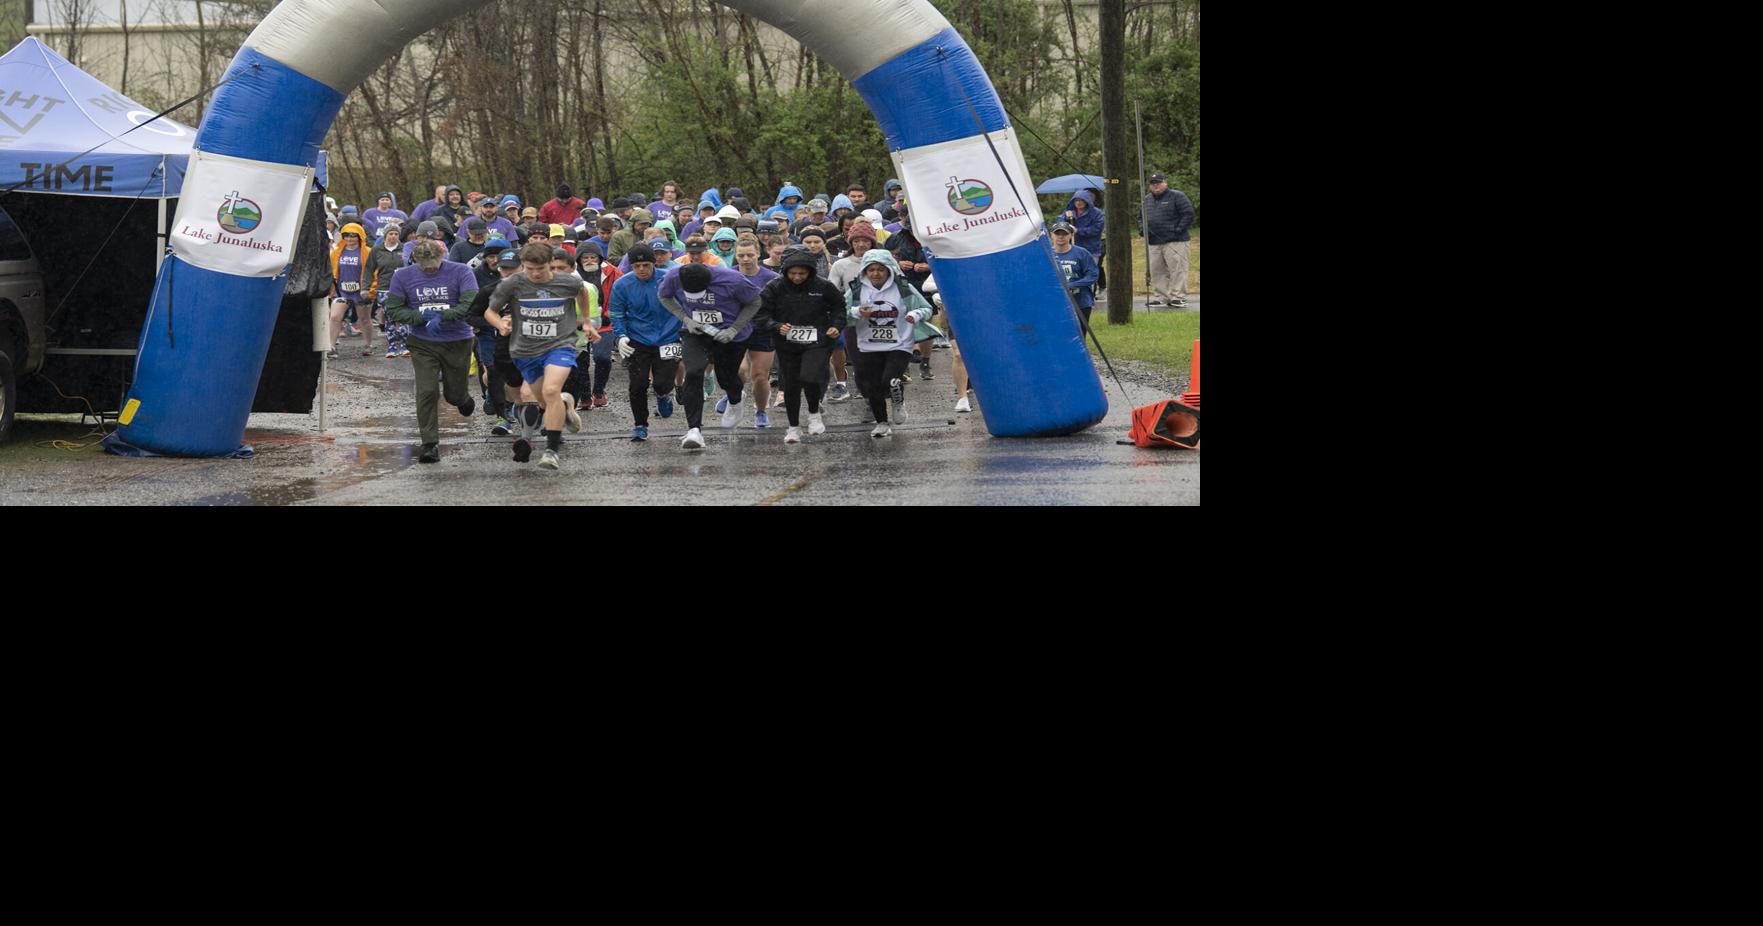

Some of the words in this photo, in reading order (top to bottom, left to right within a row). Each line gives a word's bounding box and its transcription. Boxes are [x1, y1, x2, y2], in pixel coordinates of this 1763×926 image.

[20, 162, 114, 192] TIME
[926, 222, 960, 236] Lake
[963, 207, 1030, 232] Junaluska
[182, 225, 212, 241] Lake
[213, 232, 283, 253] Junaluska
[416, 286, 449, 297] LOVE
[698, 312, 718, 323] 126
[529, 324, 551, 336] 197
[791, 329, 813, 341] 227
[871, 328, 893, 339] 228
